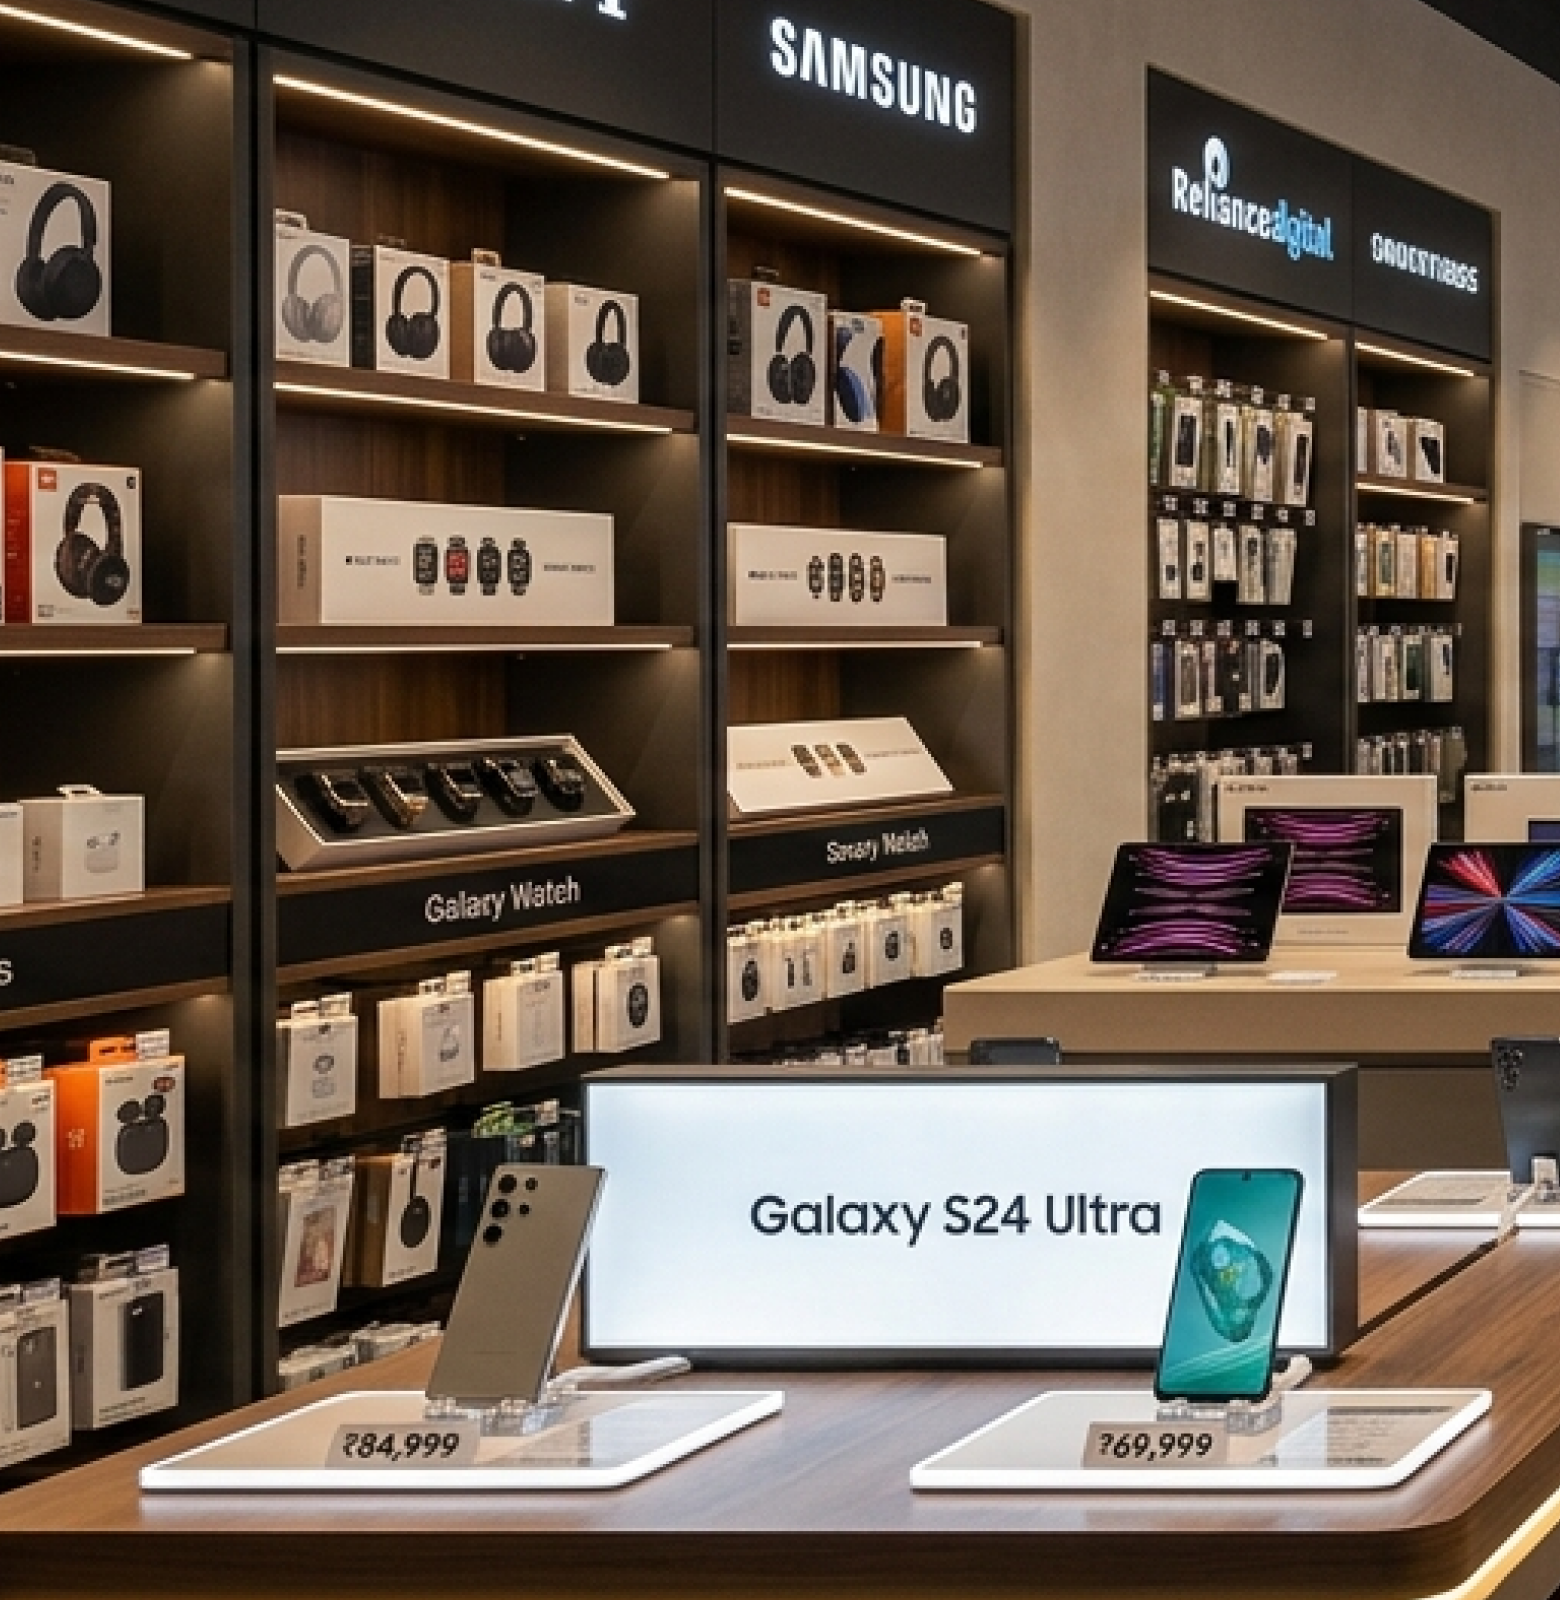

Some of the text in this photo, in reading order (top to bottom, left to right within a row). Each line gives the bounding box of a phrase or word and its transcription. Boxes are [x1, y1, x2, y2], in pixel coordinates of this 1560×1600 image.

[770, 17, 976, 134] SAMSUNG
[749, 1191, 1162, 1247] Galaxy S24 Ultra
